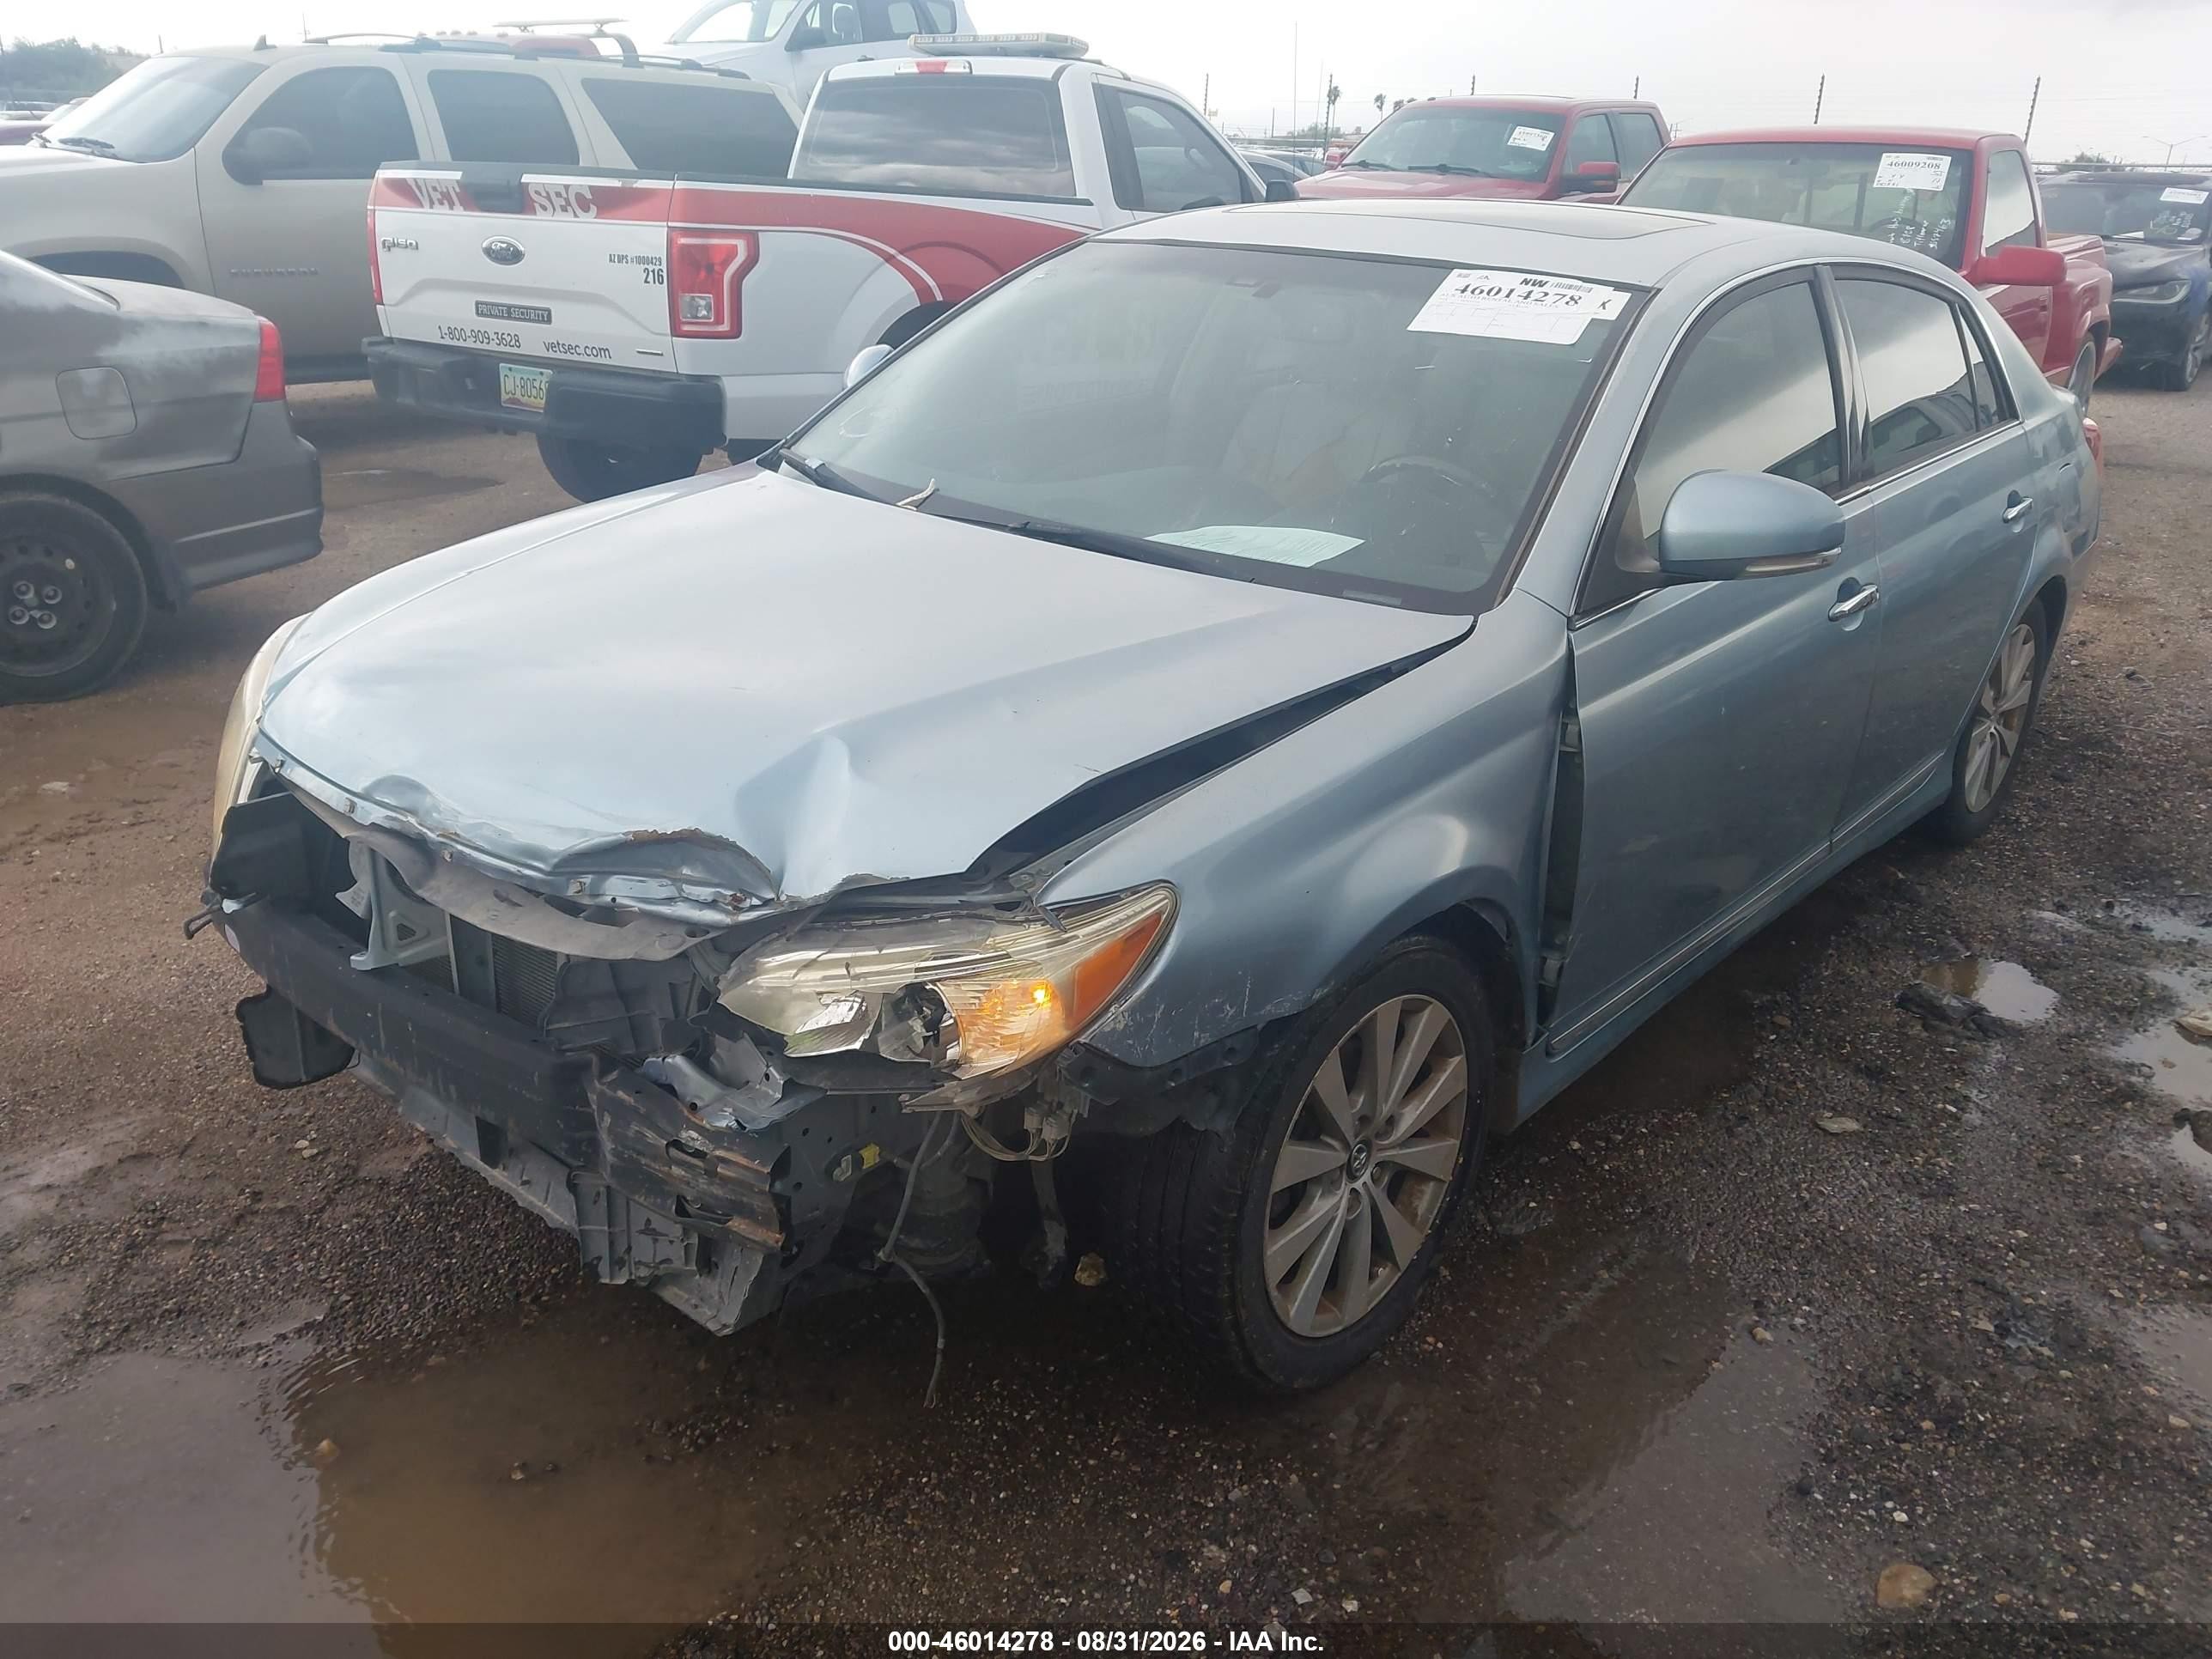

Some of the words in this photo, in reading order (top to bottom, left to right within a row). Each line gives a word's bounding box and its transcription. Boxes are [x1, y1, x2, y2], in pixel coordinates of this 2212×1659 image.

[406, 178, 465, 211] VET
[527, 182, 598, 219] SEC
[608, 253, 617, 264] AZ
[617, 253, 629, 264] DPS
[630, 255, 662, 266] #1000429
[643, 267, 665, 285] 216
[1519, 277, 1549, 289] NW
[1454, 283, 1583, 307] 46014278
[478, 304, 507, 317] PRIVATE
[510, 307, 549, 321] SECURITY
[1598, 299, 1613, 310] K
[438, 325, 521, 349] 1-800-909-3628
[543, 340, 612, 359] vetsec.com
